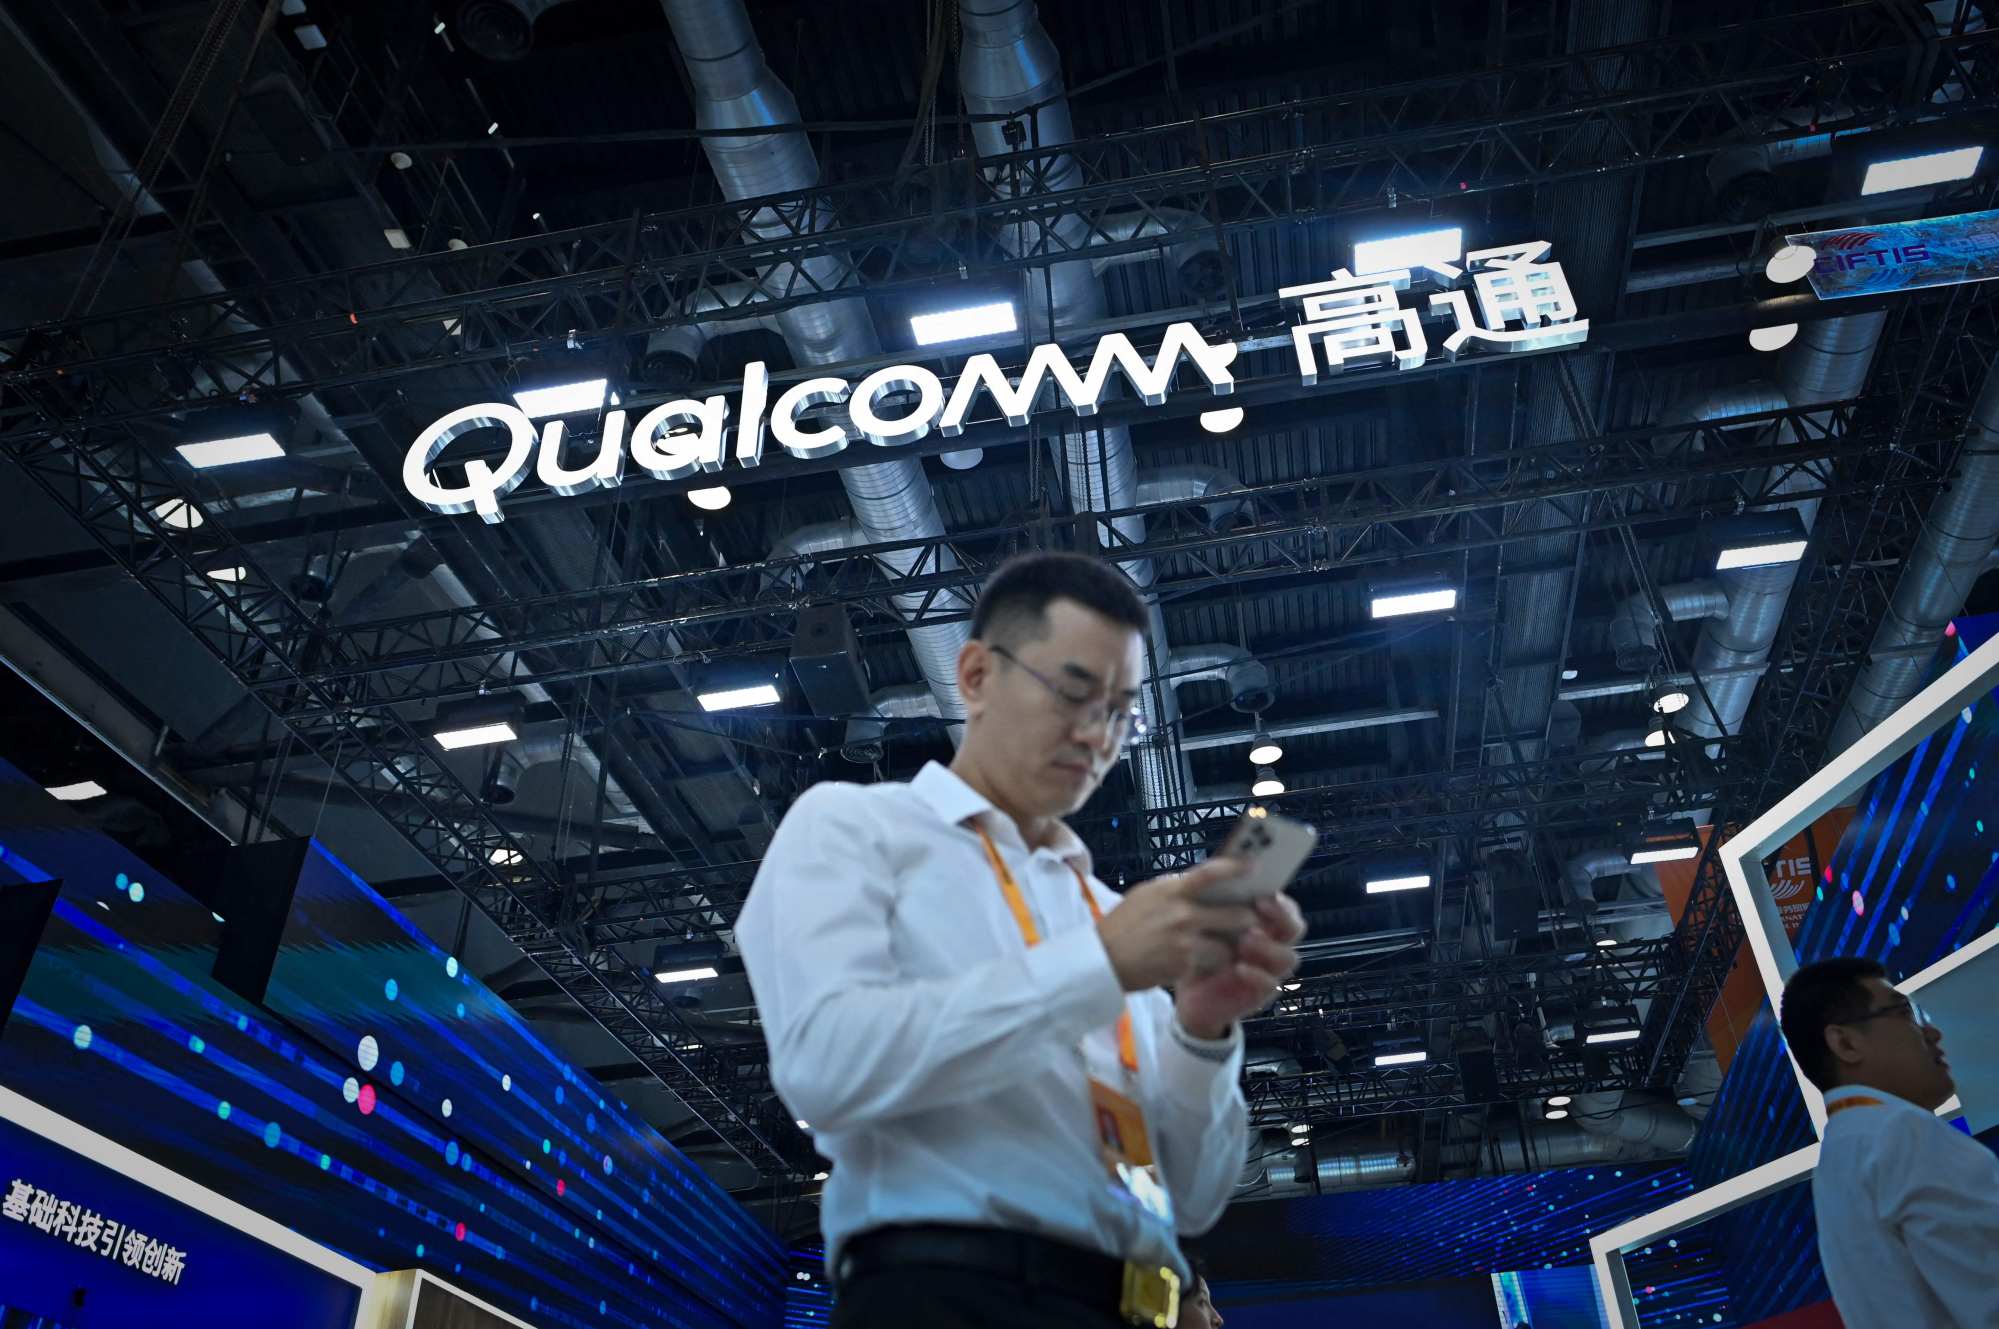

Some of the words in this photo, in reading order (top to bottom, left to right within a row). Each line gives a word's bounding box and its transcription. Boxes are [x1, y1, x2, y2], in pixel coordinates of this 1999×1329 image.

[1813, 245, 1931, 273] CIFTIS
[403, 322, 1234, 523] Qualcomm
[1278, 240, 1589, 386] 高通
[2, 1178, 187, 1285] 基础科技引领创新
